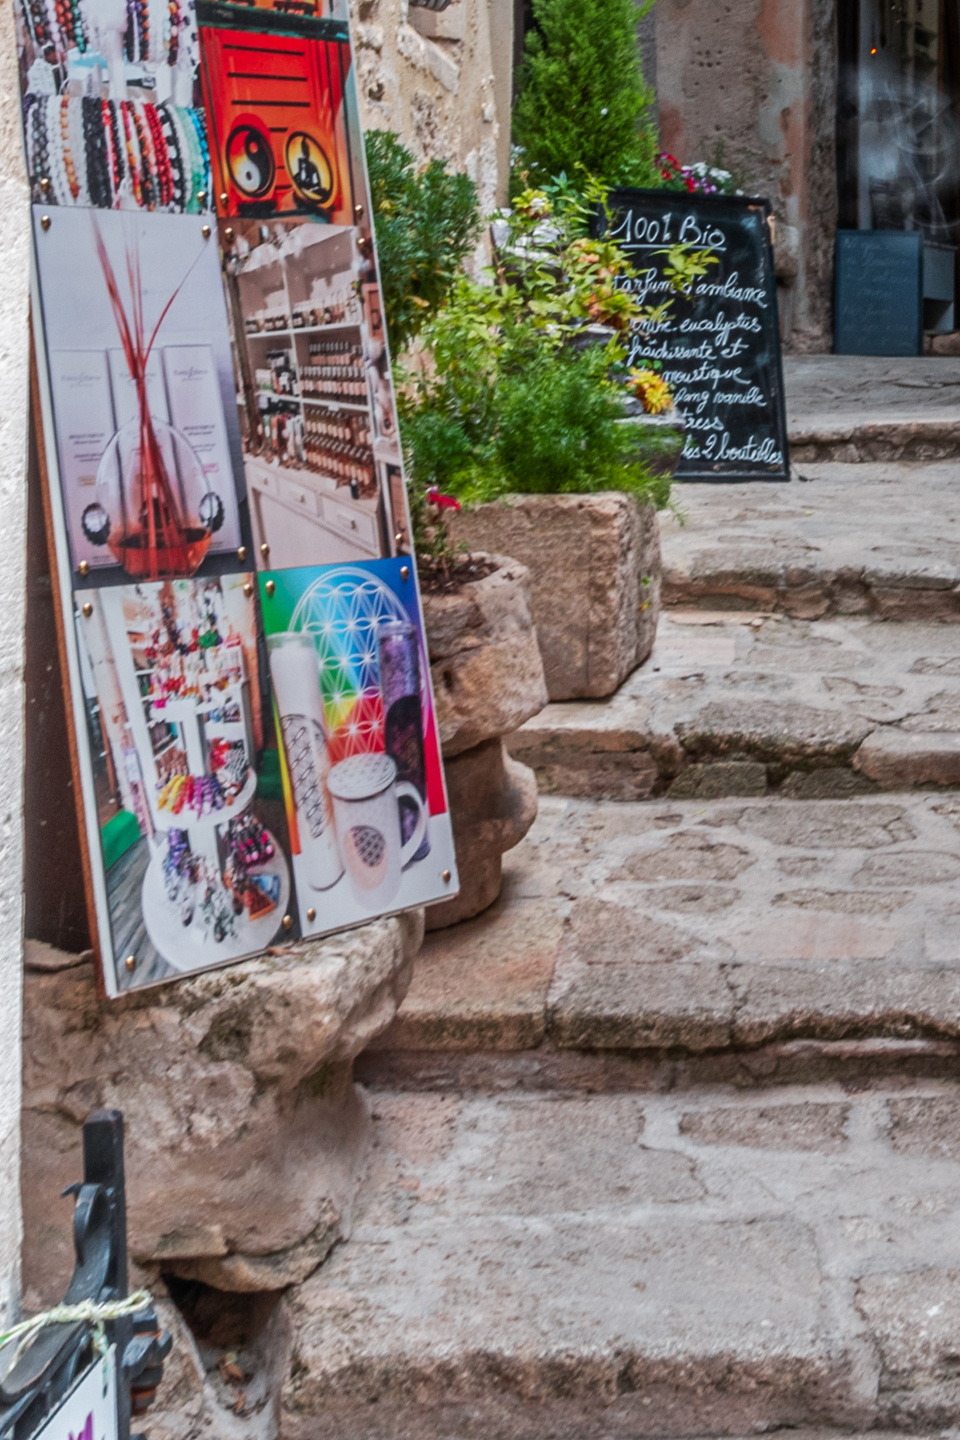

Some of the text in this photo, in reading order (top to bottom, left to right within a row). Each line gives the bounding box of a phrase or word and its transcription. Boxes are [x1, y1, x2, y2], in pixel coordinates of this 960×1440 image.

[609, 208, 726, 247] 100% Bio
[720, 338, 749, 358] et
[701, 433, 718, 459] 2
[714, 431, 784, 464] bouteilles
